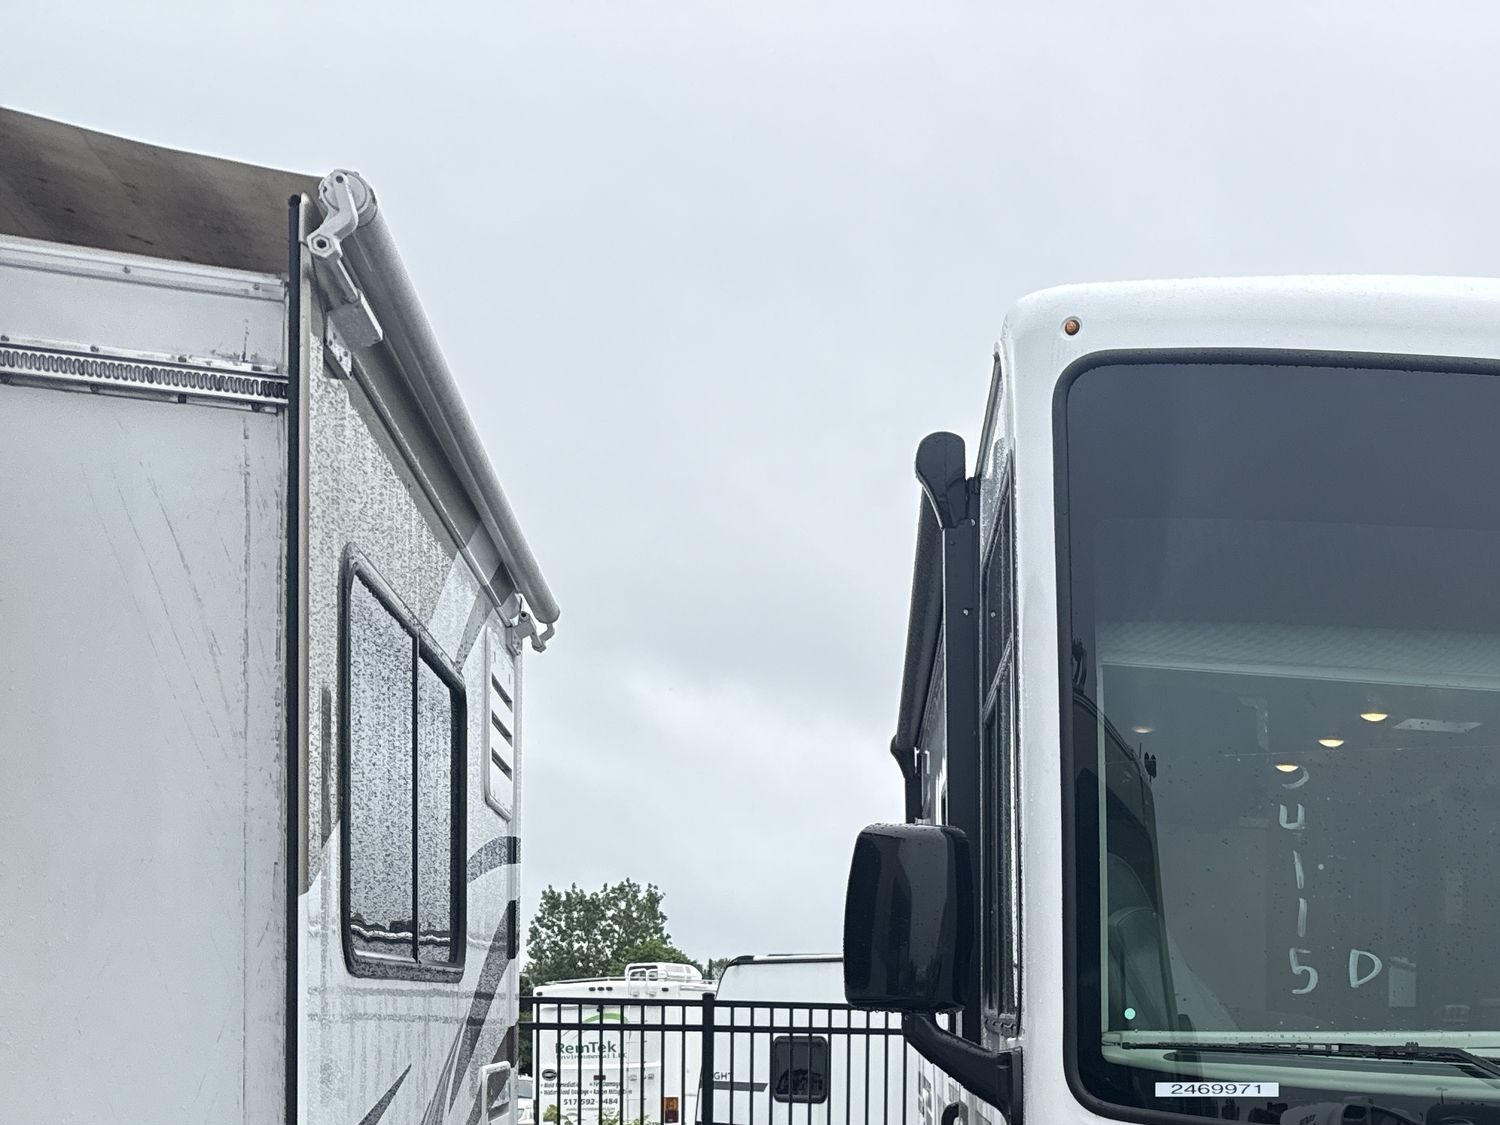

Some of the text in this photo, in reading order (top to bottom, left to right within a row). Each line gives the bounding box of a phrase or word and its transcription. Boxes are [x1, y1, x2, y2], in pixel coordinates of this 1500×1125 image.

[555, 1041, 617, 1054] RemTek
[1170, 1083, 1263, 1095] 2469971
[563, 1098, 618, 1106] 517592-484
